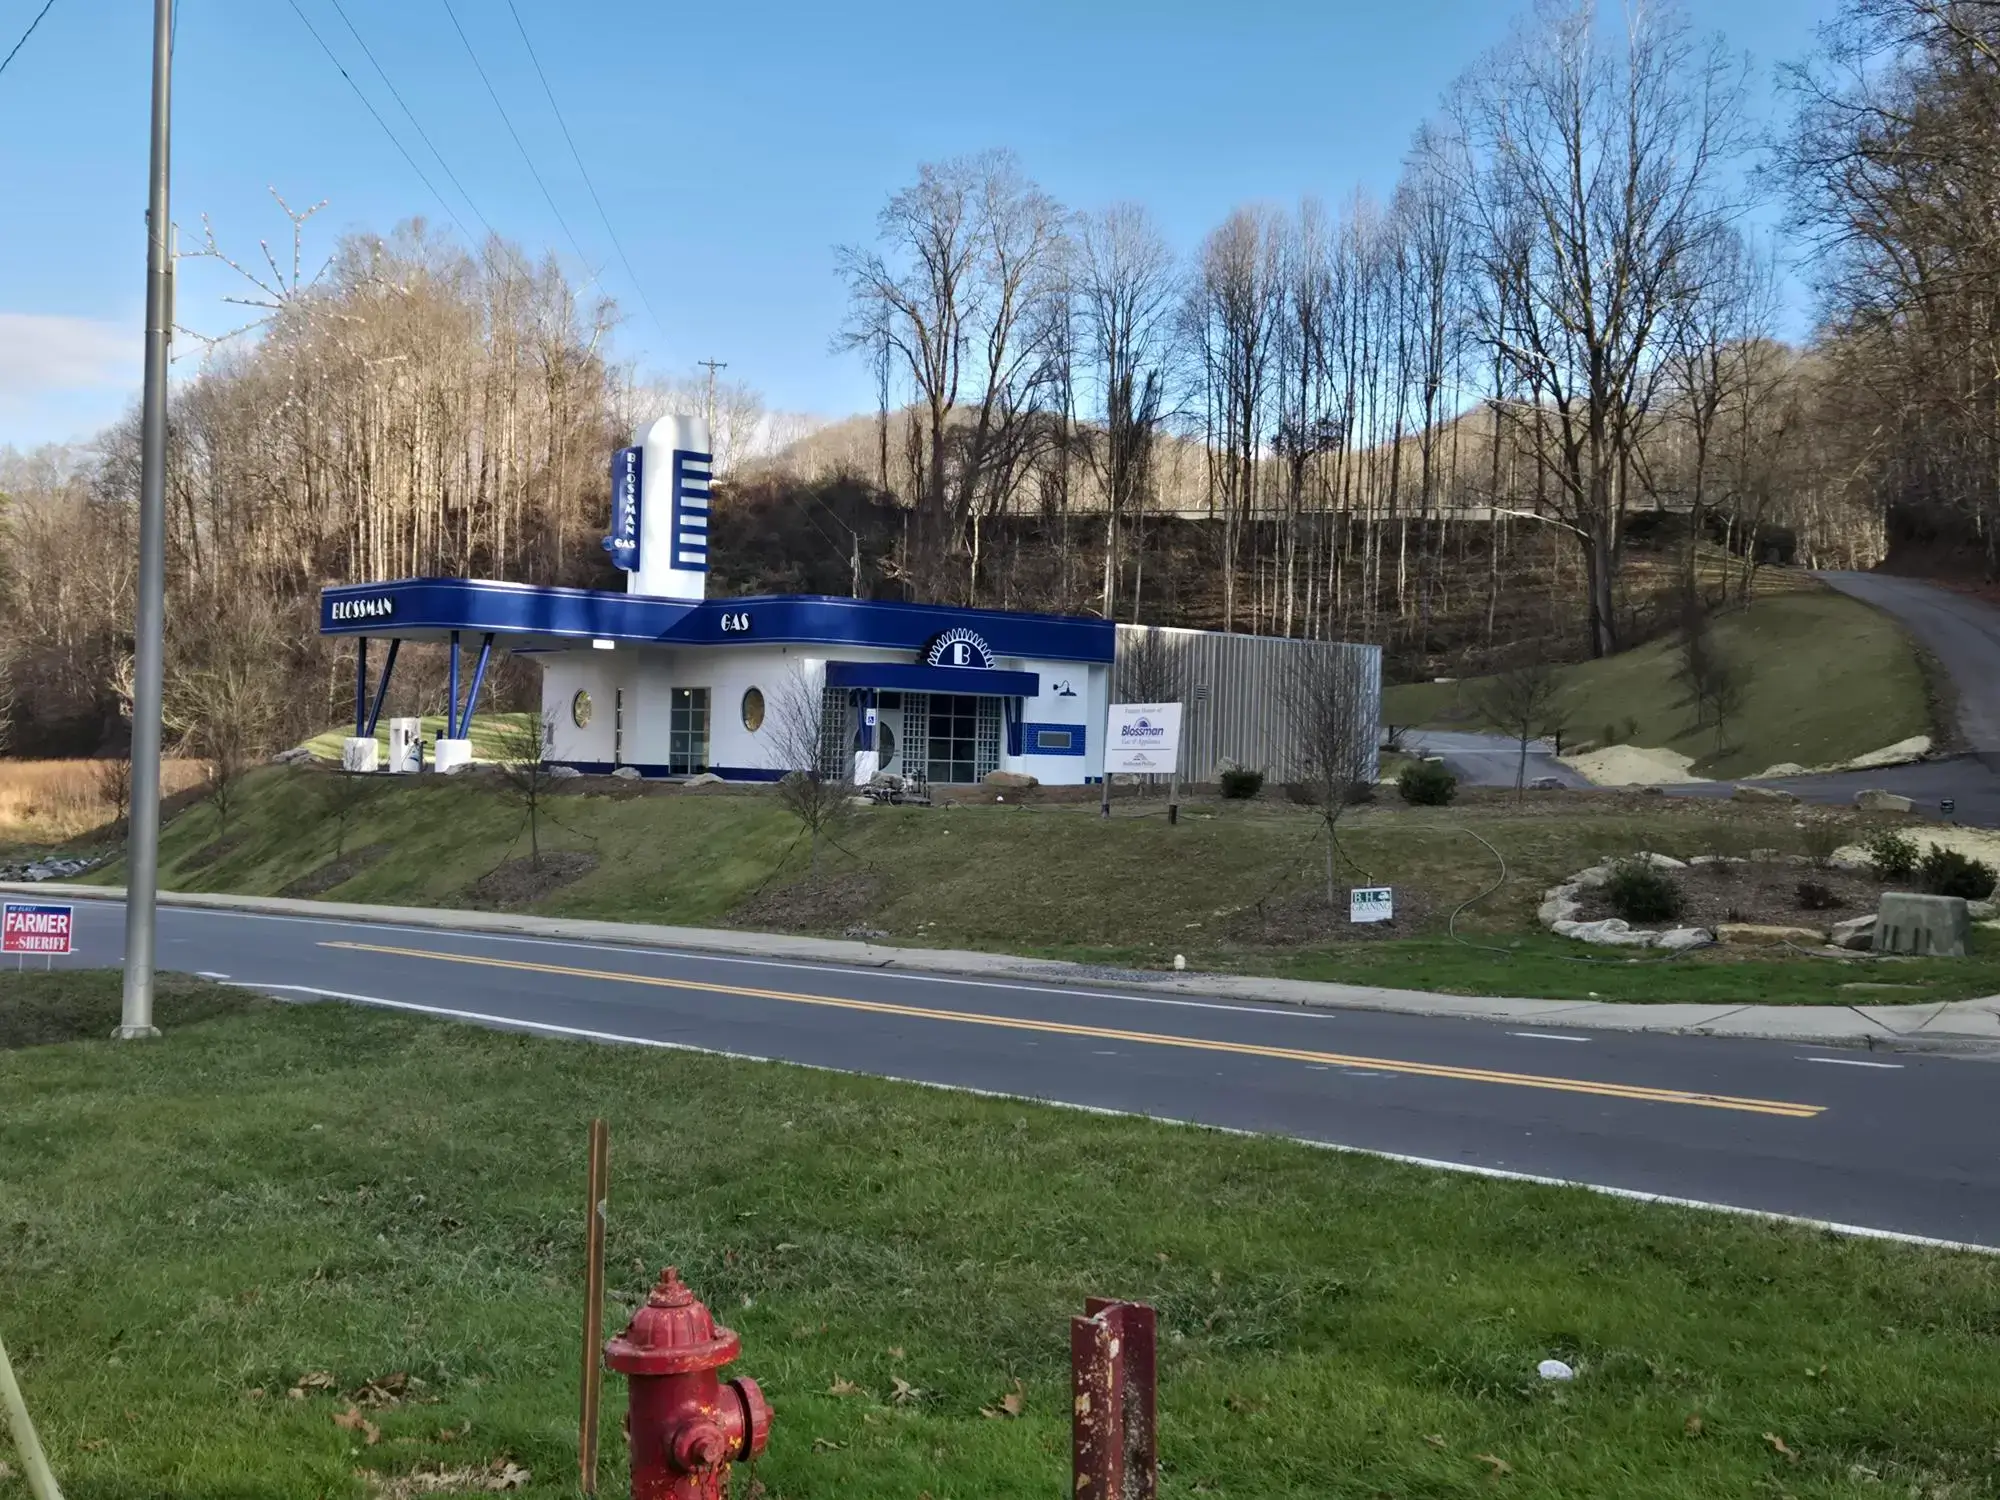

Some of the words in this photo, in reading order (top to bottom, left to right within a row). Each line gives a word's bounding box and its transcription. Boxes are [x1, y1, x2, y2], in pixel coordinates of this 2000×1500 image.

[625, 452, 636, 535] BLOSSMAN
[614, 539, 636, 549] GAS
[331, 597, 393, 620] BLOSSMAN
[720, 612, 749, 632] GAS
[953, 643, 971, 665] B
[1121, 725, 1164, 736] Blossman
[6, 912, 68, 933] FARMER
[18, 936, 67, 950] SHERIFF
